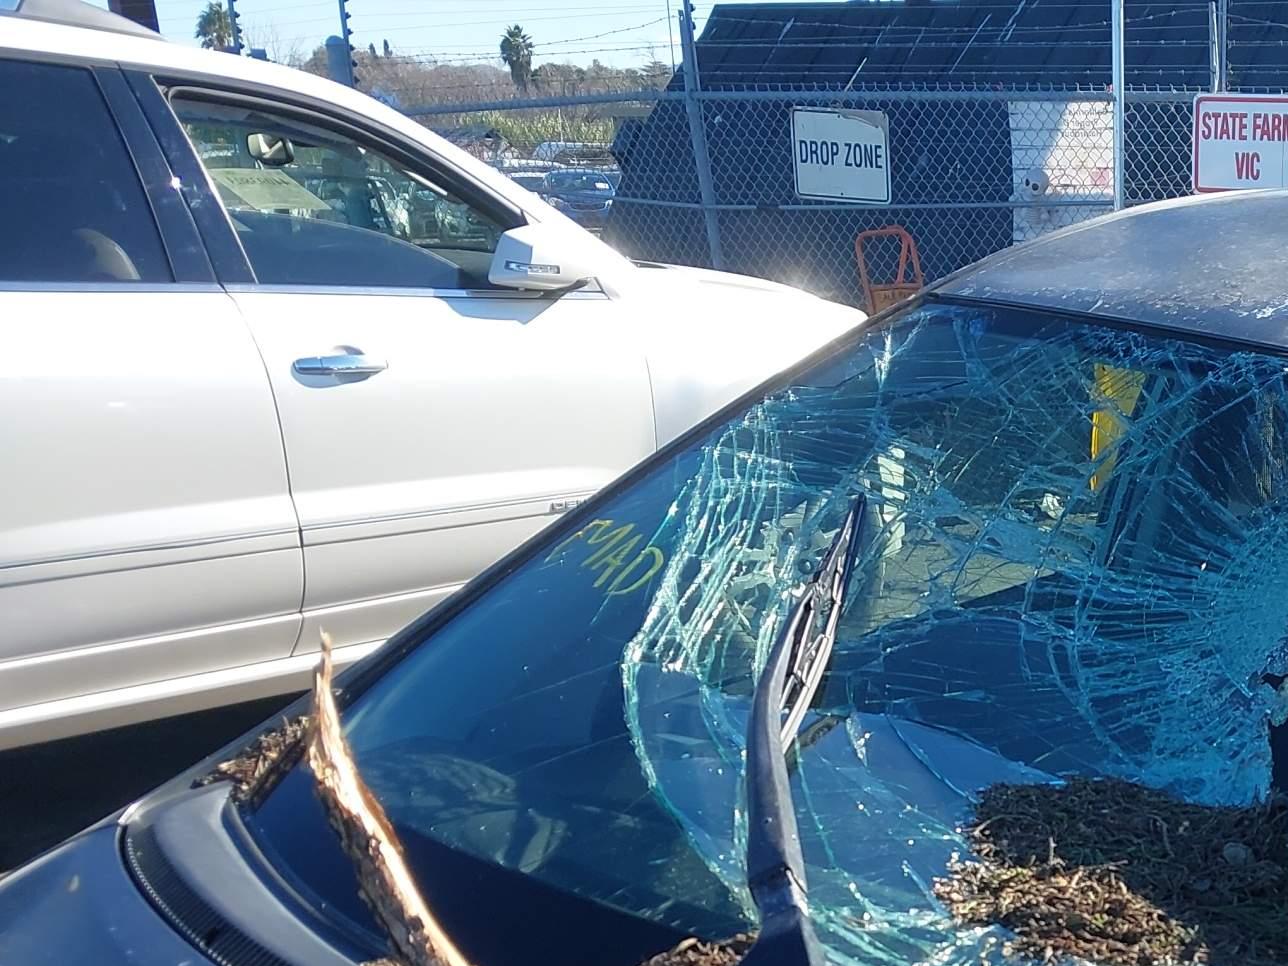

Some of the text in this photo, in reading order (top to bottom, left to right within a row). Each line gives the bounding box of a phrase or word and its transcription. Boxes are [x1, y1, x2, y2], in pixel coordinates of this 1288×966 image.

[1201, 112, 1248, 140] STATE
[799, 140, 883, 169] DROP ZONE
[1235, 152, 1261, 181] VIC
